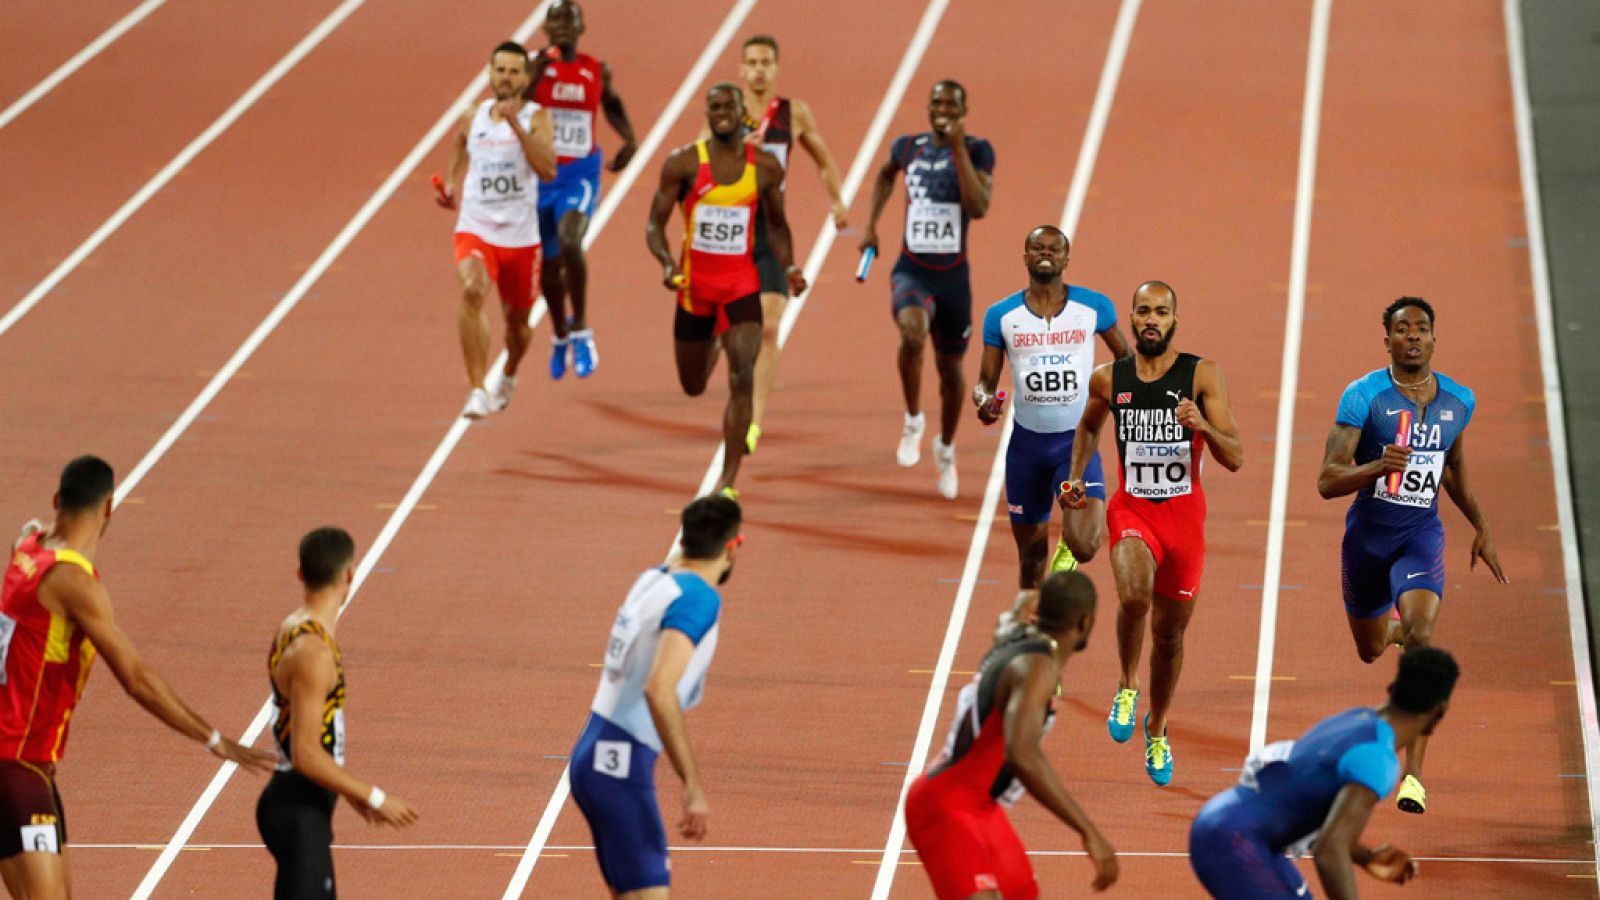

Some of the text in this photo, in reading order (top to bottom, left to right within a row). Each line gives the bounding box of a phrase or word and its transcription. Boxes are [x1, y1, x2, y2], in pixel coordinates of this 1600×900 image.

[480, 174, 523, 195] POL
[700, 221, 744, 242] ESP
[912, 221, 955, 239] FRA
[1013, 329, 1086, 347] GREAT BRITAIN
[1040, 354, 1072, 365] TDK
[1025, 370, 1078, 392] GBR
[1025, 394, 1060, 403] LONDON
[1119, 424, 1184, 441] &TOBAGO
[1145, 446, 1181, 456] TDK
[1408, 454, 1436, 465] TDK
[1130, 462, 1186, 484] TTO
[1386, 470, 1437, 493] SA
[1128, 486, 1168, 496] LONDON
[1377, 490, 1417, 504] LONDON
[605, 748, 619, 771] 3
[34, 833, 48, 852] 6
